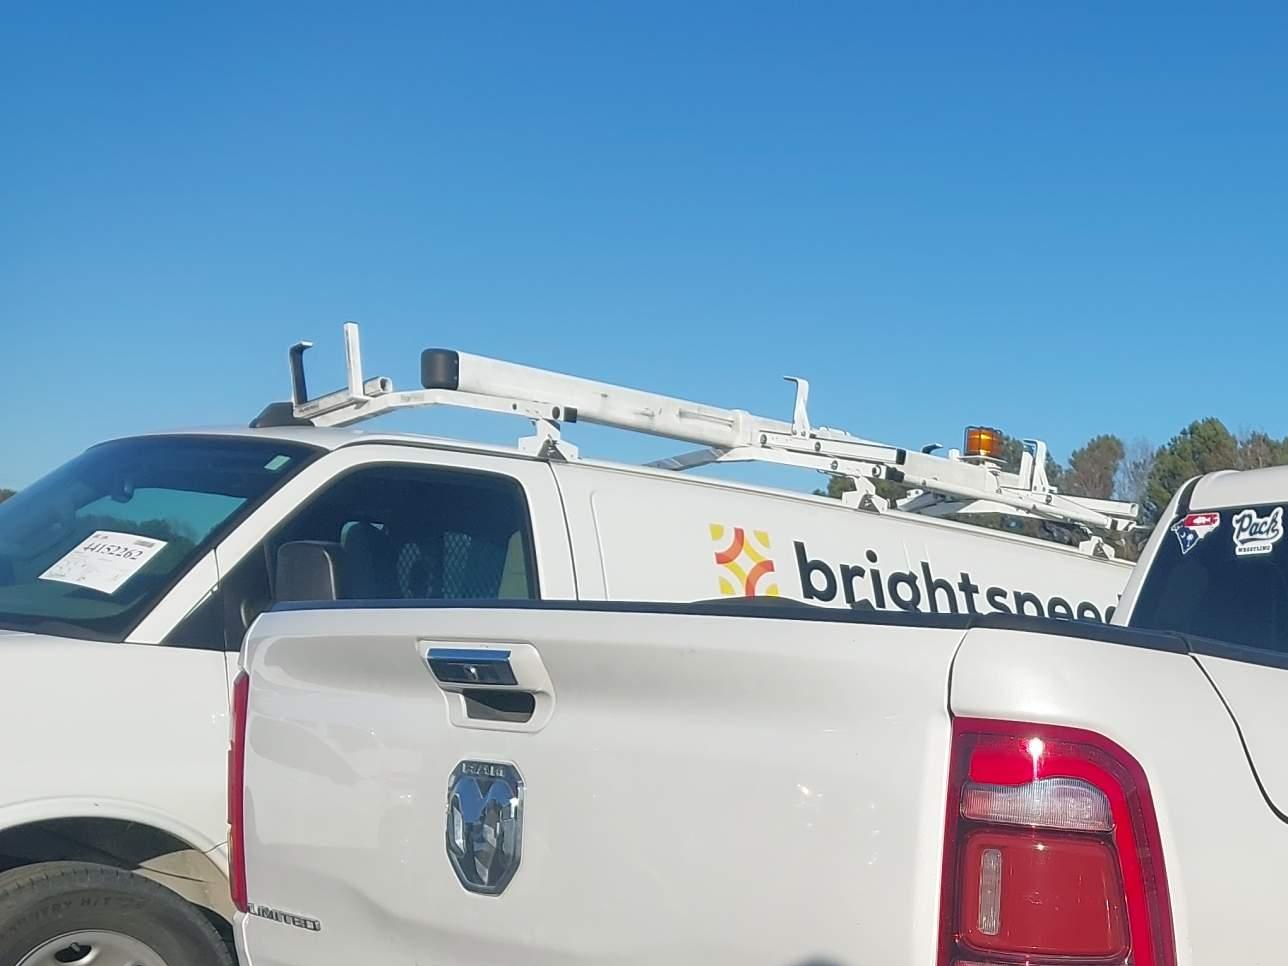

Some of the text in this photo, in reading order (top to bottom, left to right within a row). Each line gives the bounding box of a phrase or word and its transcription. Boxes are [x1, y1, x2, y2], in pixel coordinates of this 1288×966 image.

[1235, 511, 1280, 543] Pack
[82, 542, 143, 561] 44152262
[793, 540, 1122, 625] brightspee
[247, 902, 321, 932] LIMITED
